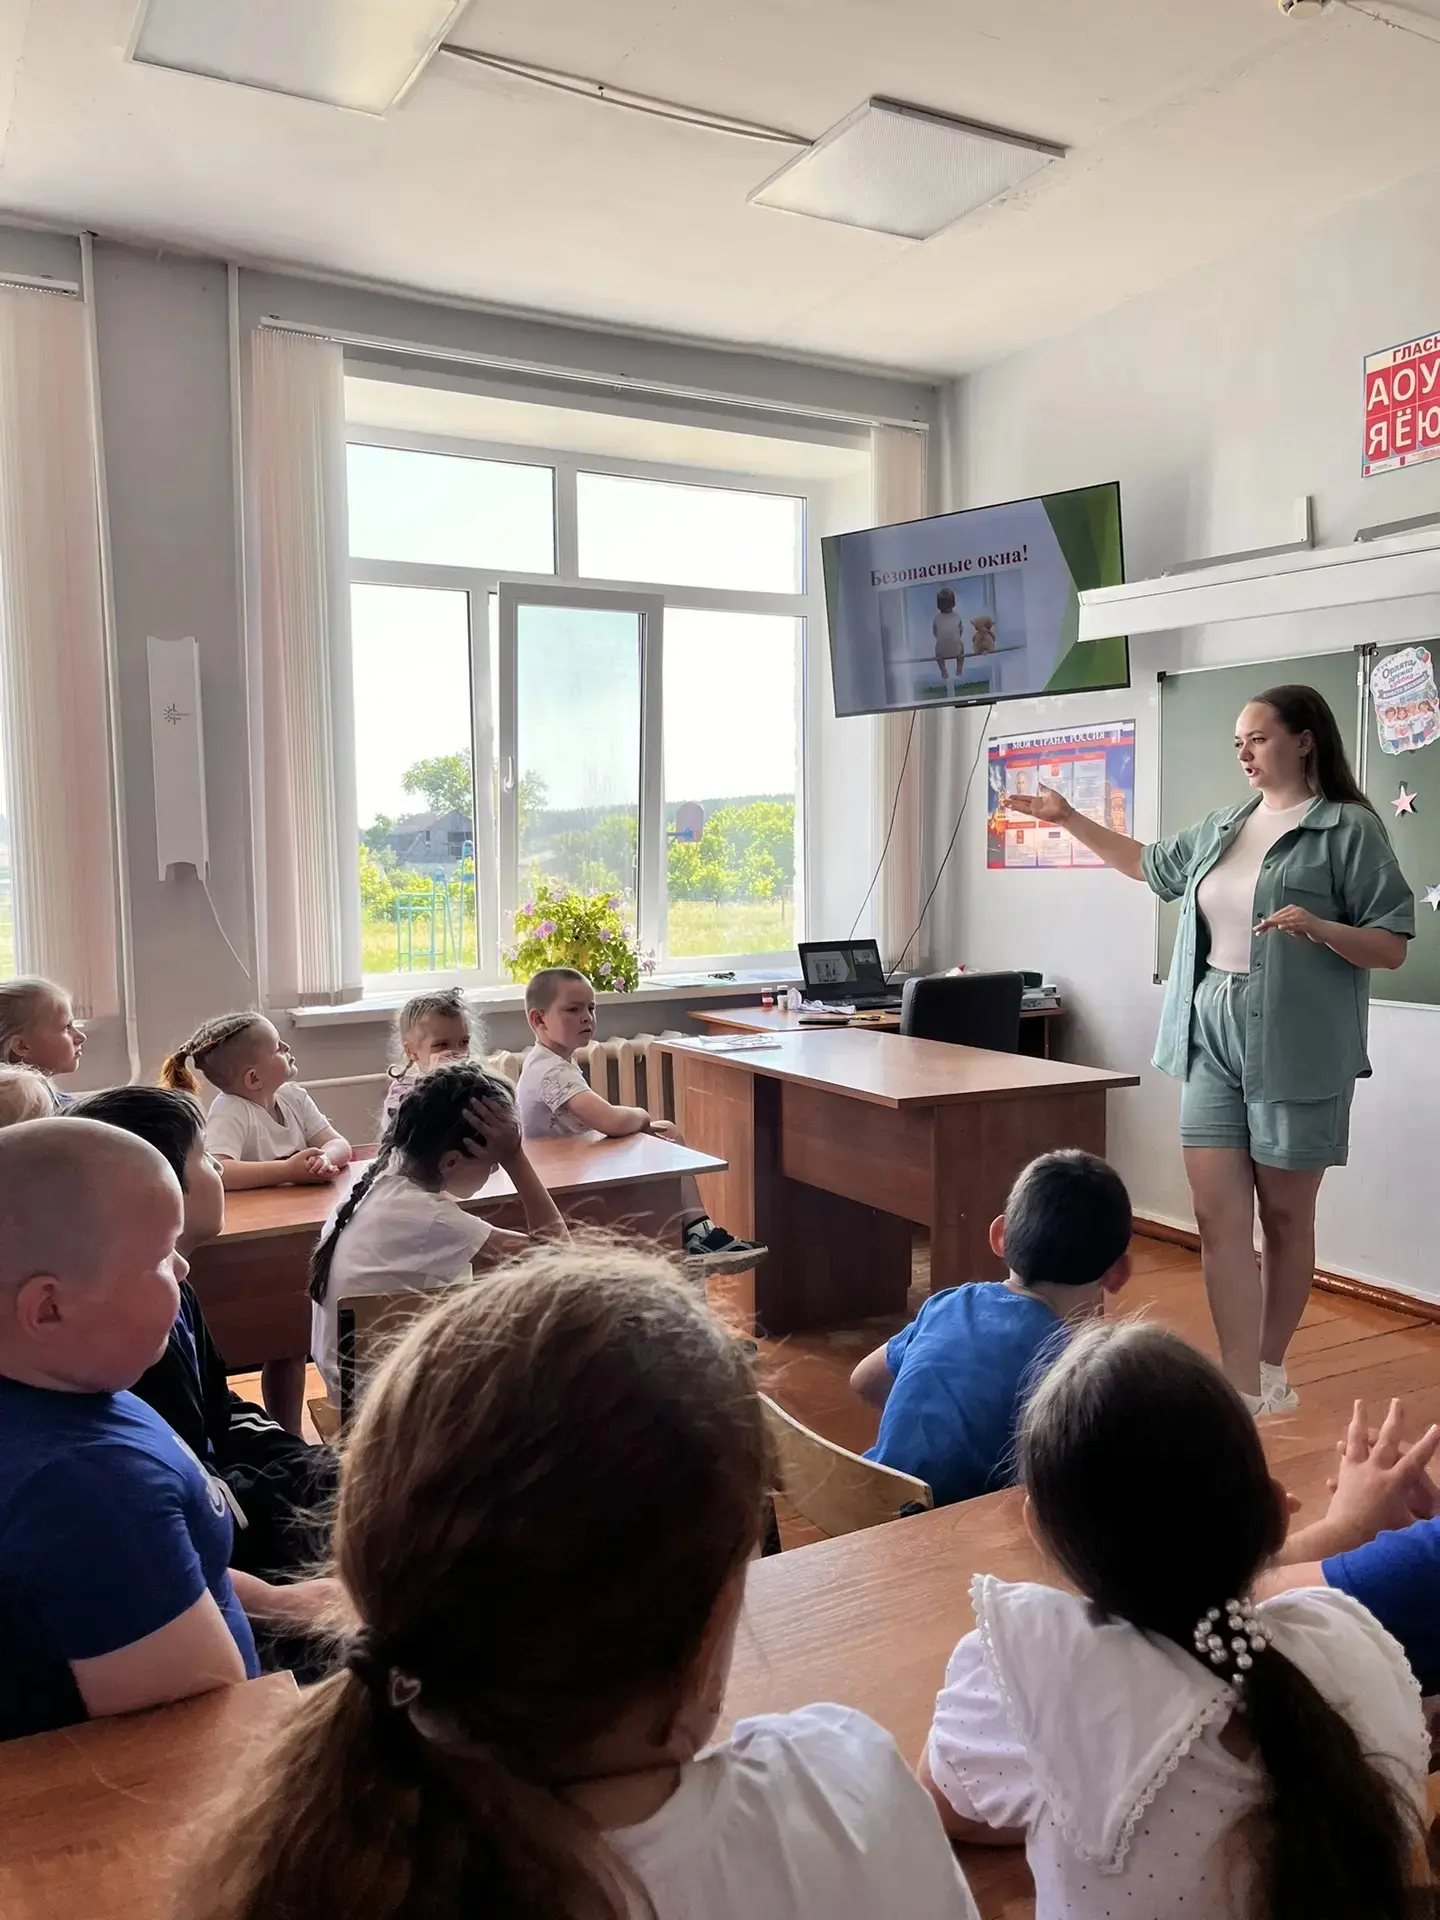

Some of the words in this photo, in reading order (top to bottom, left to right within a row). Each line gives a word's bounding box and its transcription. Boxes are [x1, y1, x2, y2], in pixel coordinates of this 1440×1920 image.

[869, 558, 973, 587] Безопасные
[977, 544, 1029, 569] окна!
[1012, 740, 1031, 750] МОЯ
[1033, 735, 1067, 748] СТРАНА
[1069, 731, 1105, 744] РОССИЯ
